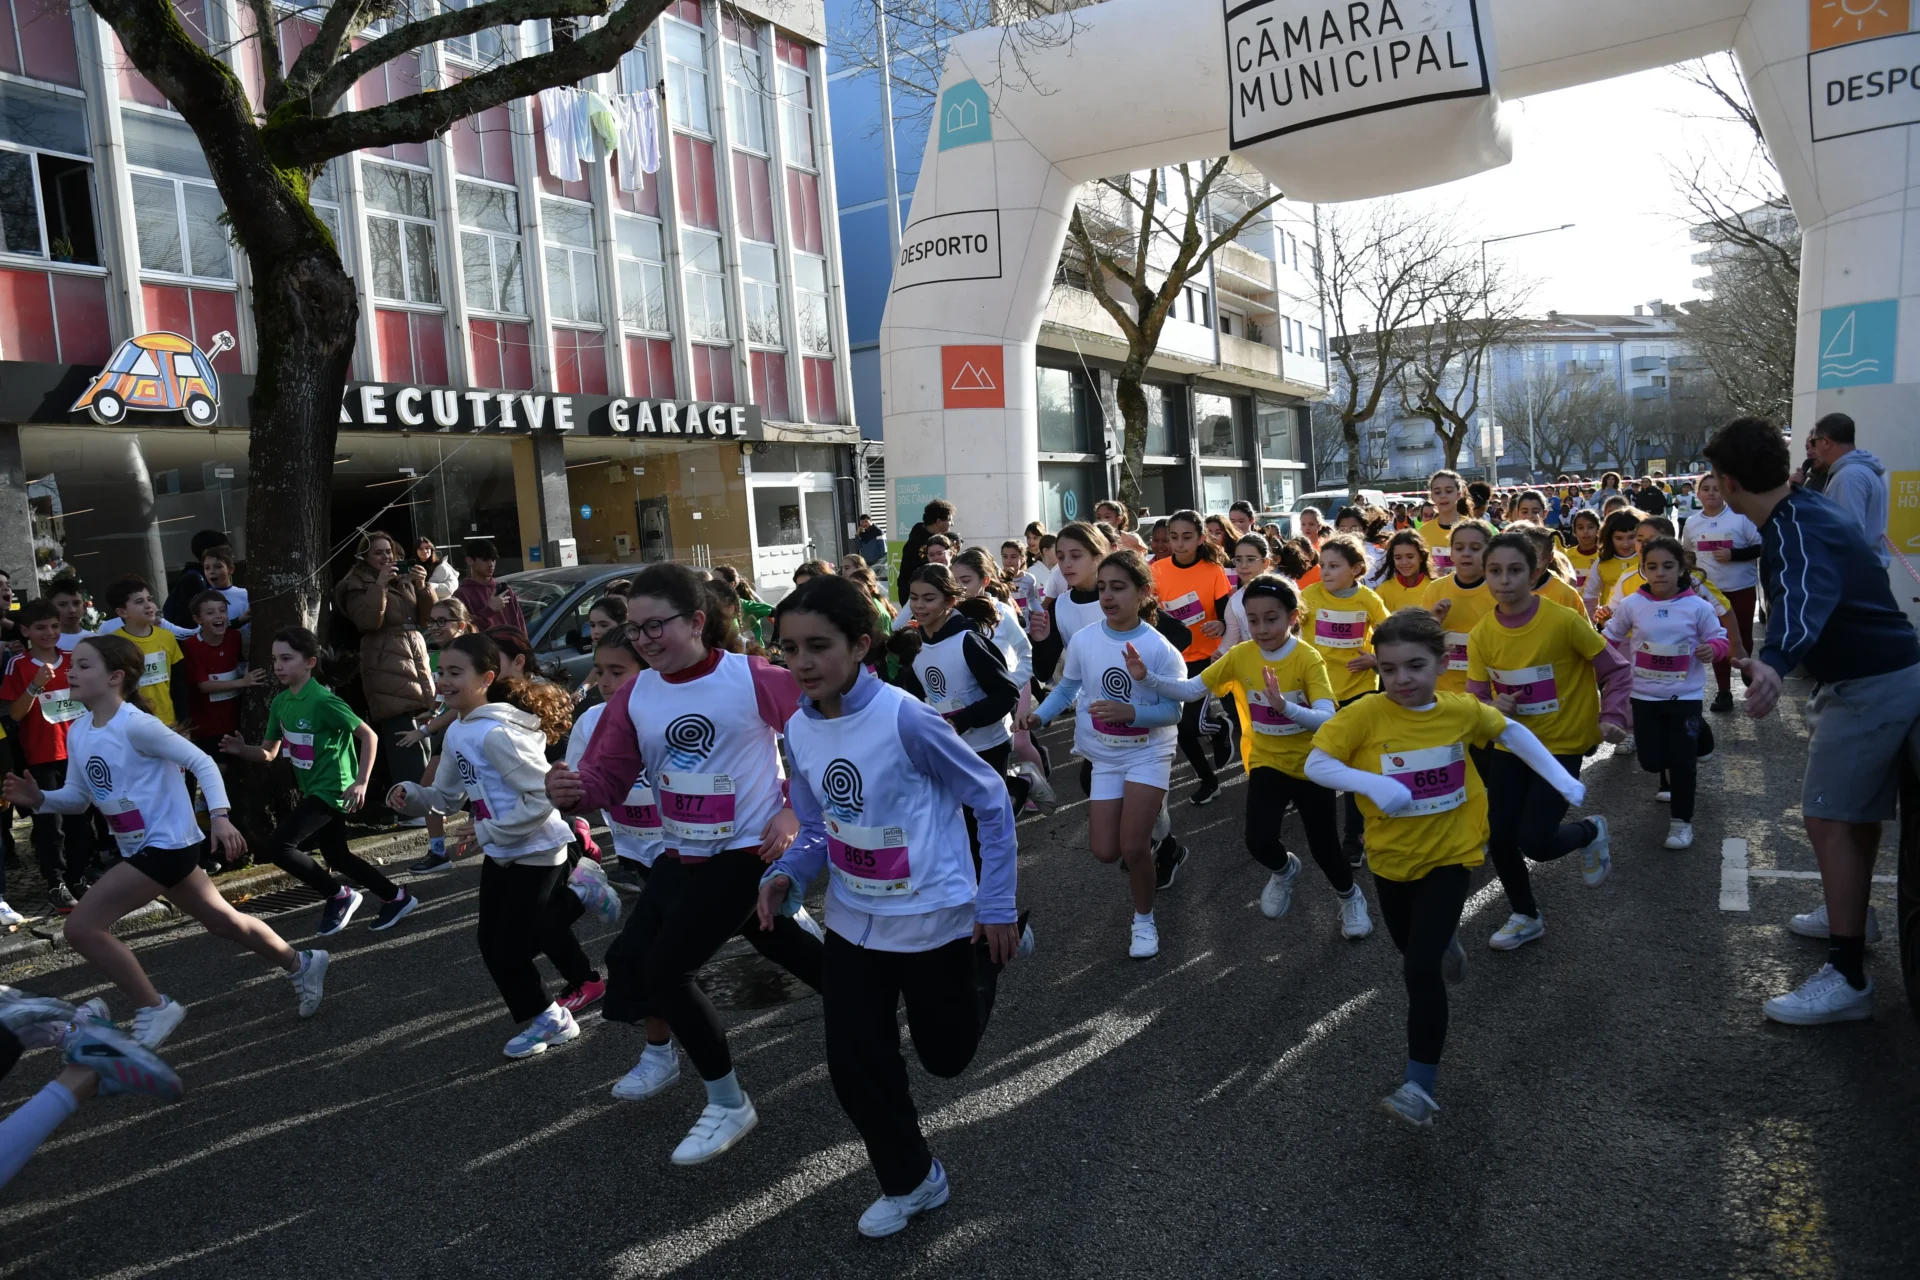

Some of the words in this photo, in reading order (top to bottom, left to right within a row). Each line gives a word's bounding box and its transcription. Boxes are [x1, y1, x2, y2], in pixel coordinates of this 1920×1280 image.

[1240, 31, 1469, 118] MUNICIPAL
[901, 234, 988, 266] DESPORTO
[608, 399, 748, 436] GARAGE
[897, 495, 910, 505] DOS
[1331, 623, 1352, 633] 662
[144, 663, 158, 672] 76
[1651, 655, 1673, 665] 565
[56, 699, 73, 709] 782
[1414, 767, 1449, 787] 665
[675, 794, 705, 812] 877
[625, 806, 652, 819] 881
[844, 845, 876, 868] 865
